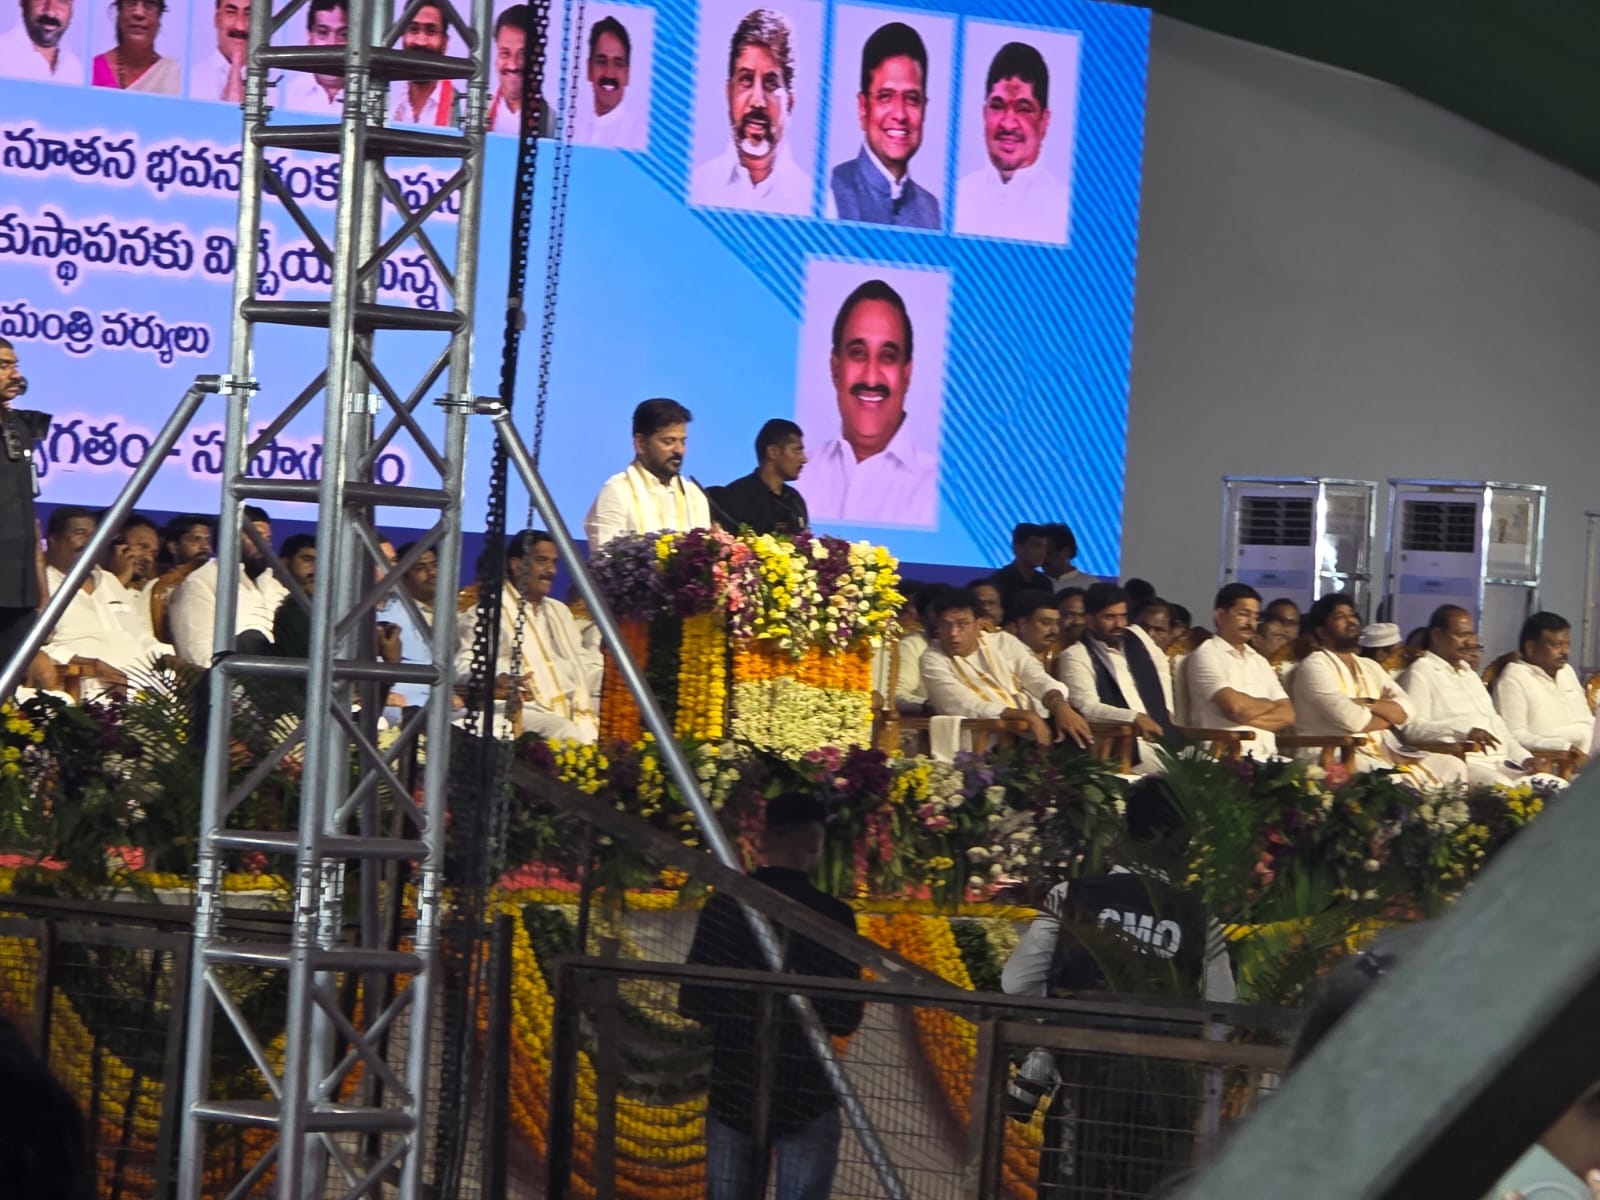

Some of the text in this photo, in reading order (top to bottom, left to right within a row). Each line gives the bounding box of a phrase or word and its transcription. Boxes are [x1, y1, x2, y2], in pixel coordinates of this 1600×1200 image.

[3, 127, 136, 179] నూతన
[1, 303, 210, 364] మంత్రి వర్యులు
